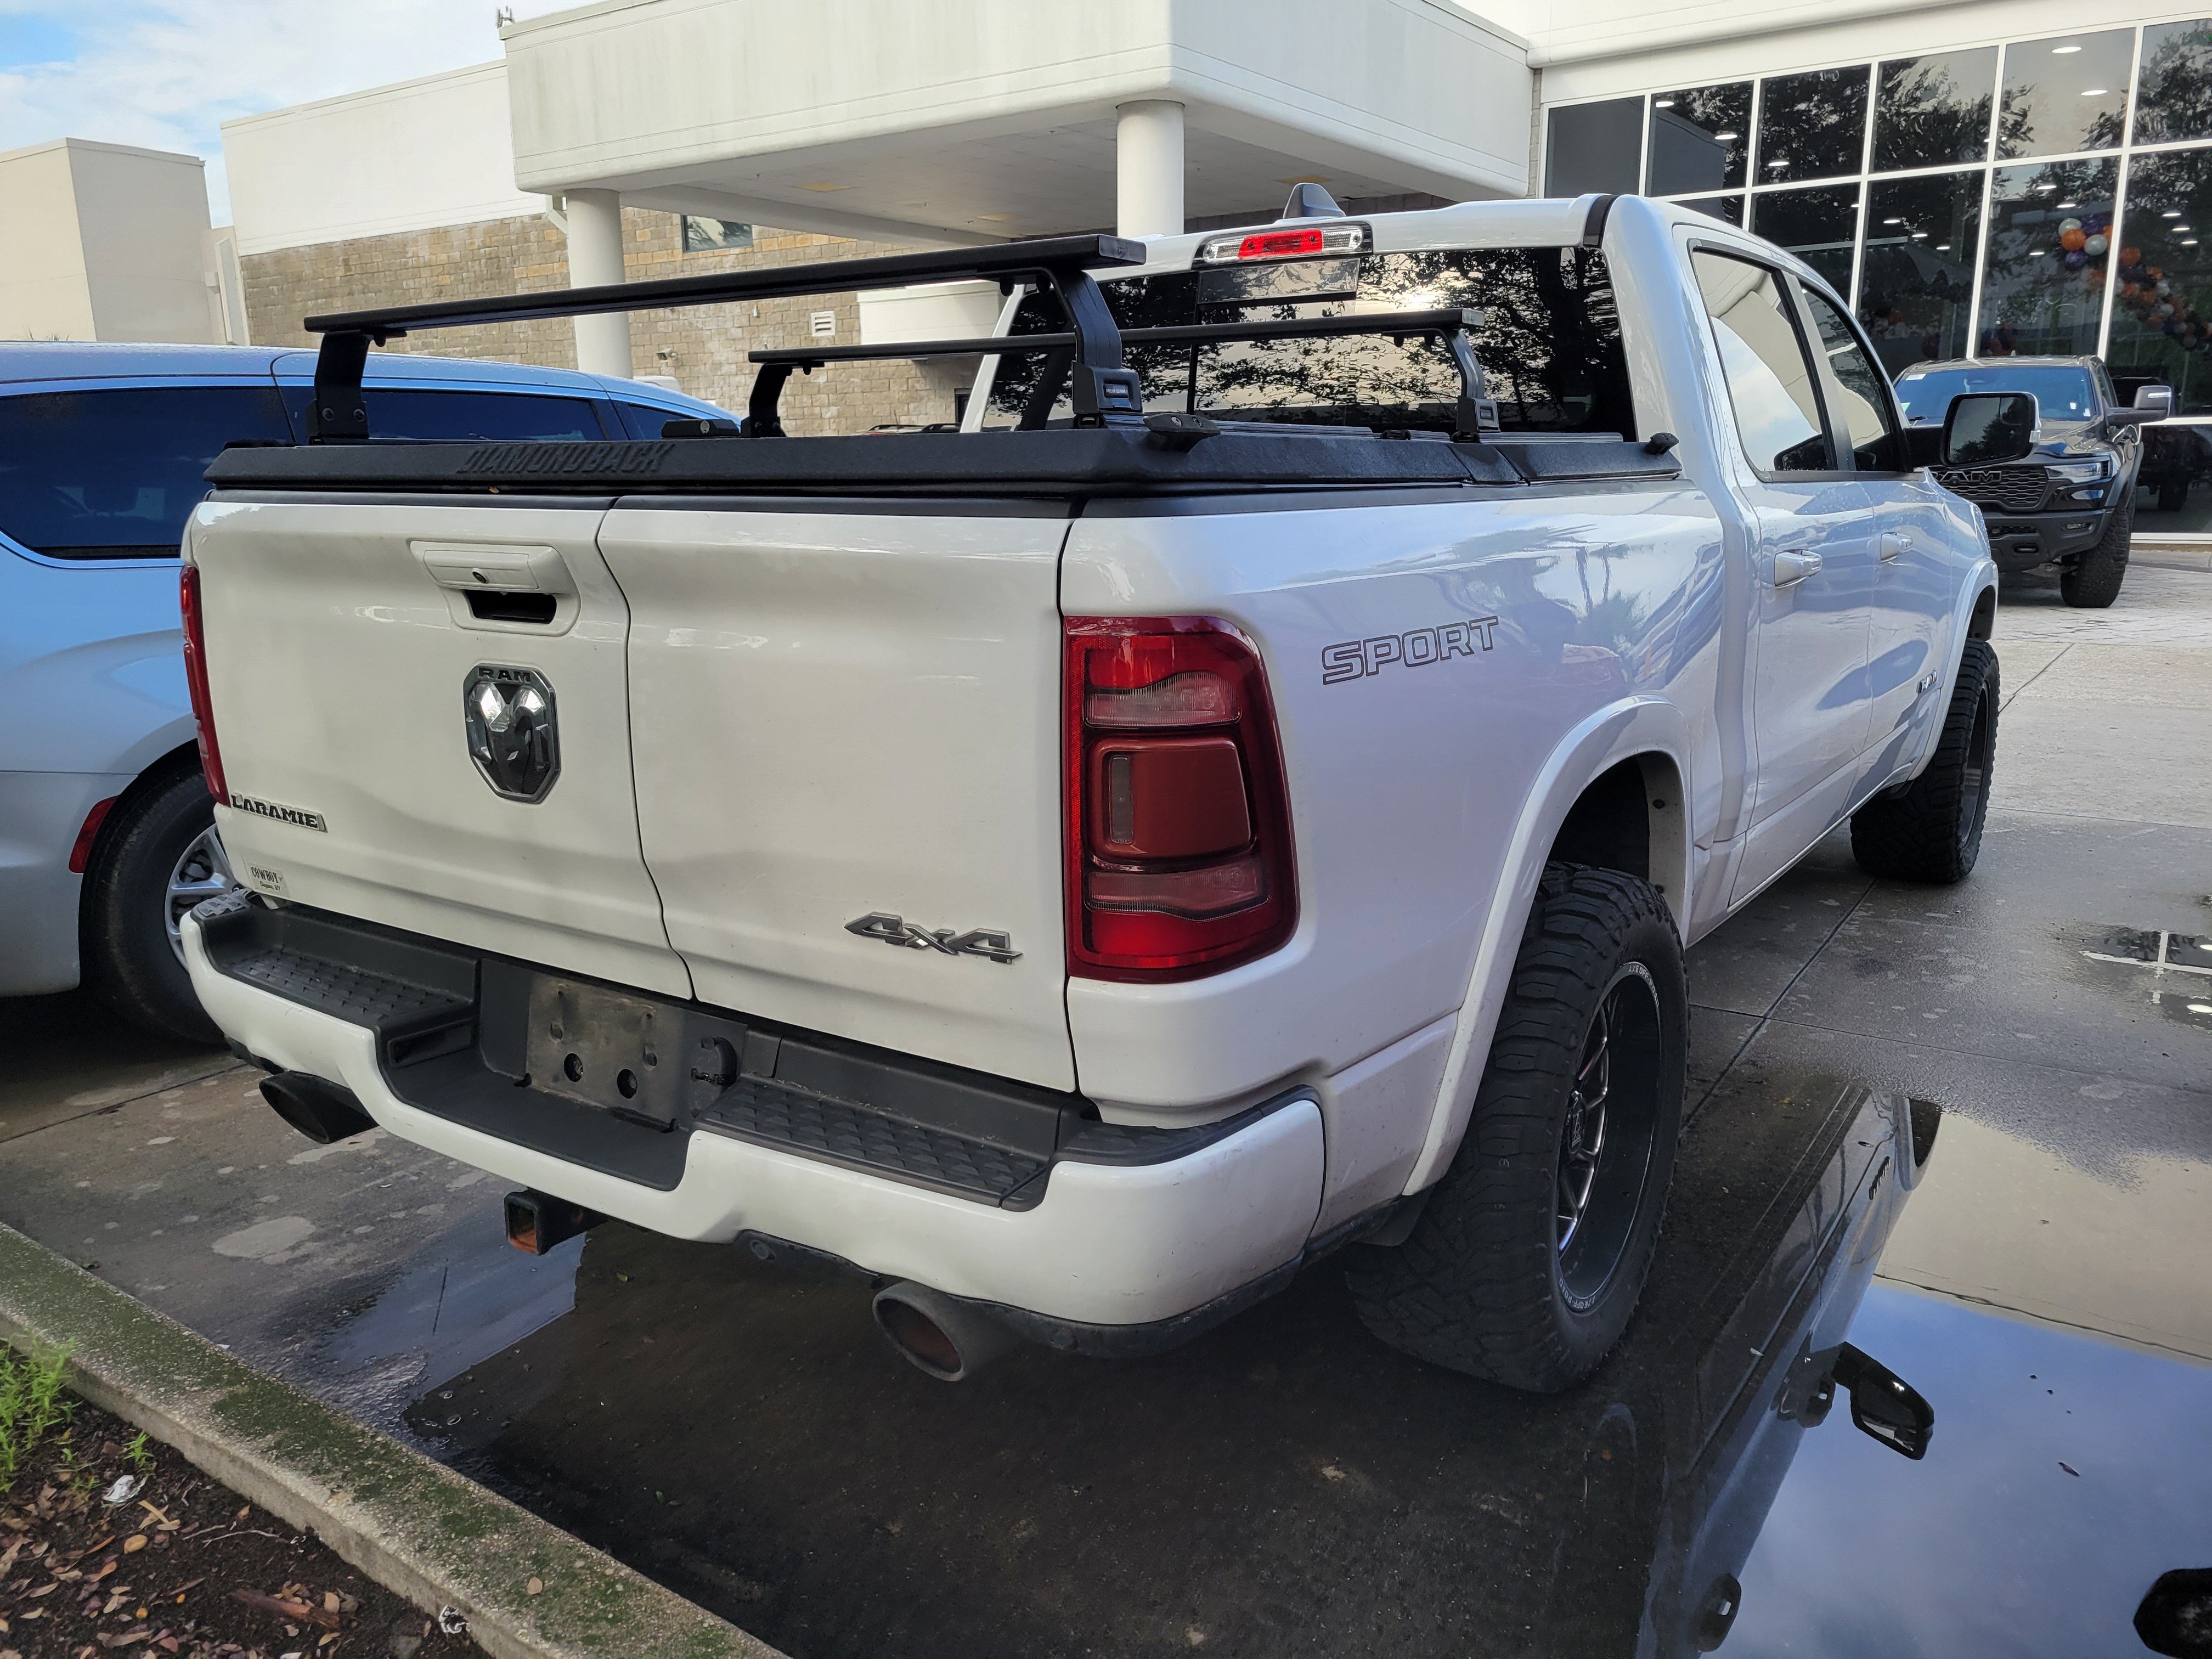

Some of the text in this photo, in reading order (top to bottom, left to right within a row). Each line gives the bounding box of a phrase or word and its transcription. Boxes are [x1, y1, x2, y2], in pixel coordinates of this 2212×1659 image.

[1322, 615, 1499, 685] SPORT
[478, 667, 531, 682] RAM
[230, 794, 319, 829] LARAMIE
[251, 866, 279, 884] COWBOY
